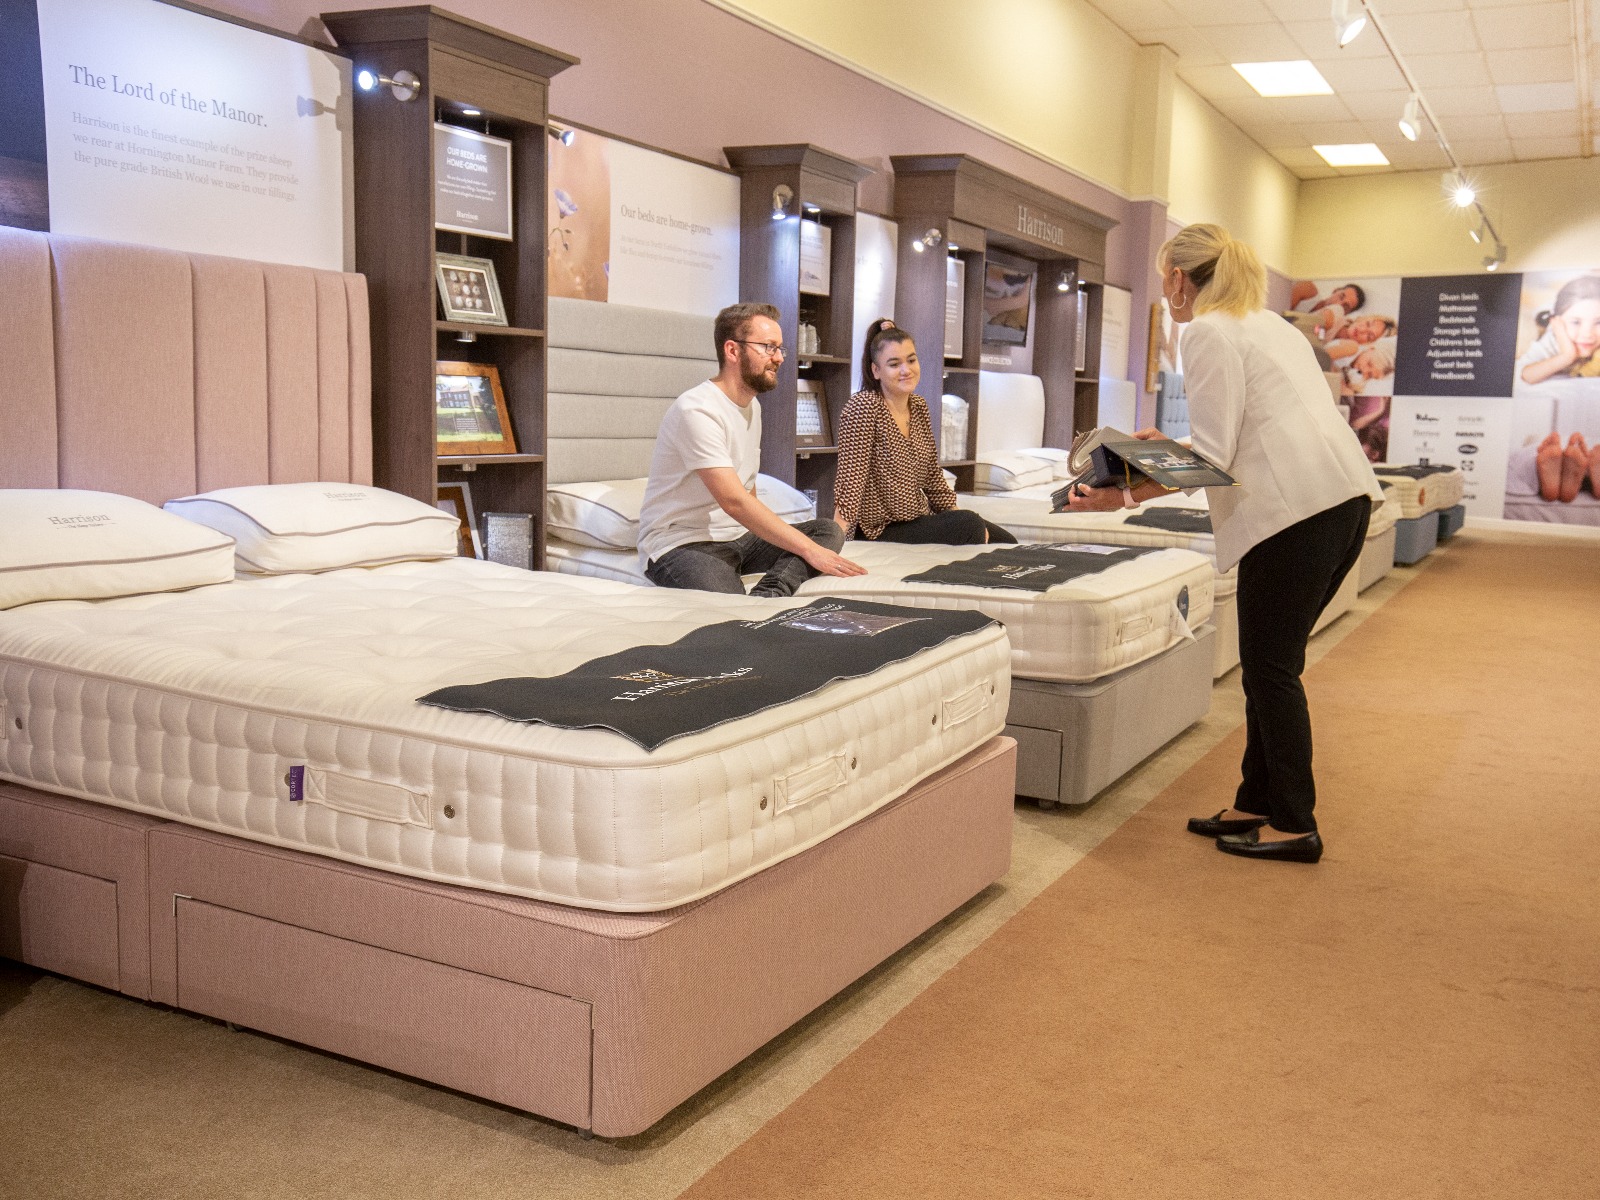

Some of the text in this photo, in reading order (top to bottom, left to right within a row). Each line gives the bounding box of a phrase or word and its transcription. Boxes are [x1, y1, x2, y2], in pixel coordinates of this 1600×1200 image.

[69, 64, 267, 127] The Lord of the Manor.
[72, 112, 120, 131] Harrison
[122, 122, 131, 133] is
[133, 125, 150, 137] the
[151, 129, 178, 144] finest
[180, 136, 218, 152] example
[220, 144, 231, 154] of
[231, 145, 246, 158] the
[447, 146, 460, 156] OUR
[460, 149, 475, 160] BEDS
[72, 133, 88, 144] we
[91, 137, 113, 149] rear
[115, 141, 125, 151] at
[127, 141, 184, 163] Hornington
[186, 153, 218, 169] Manor
[245, 165, 267, 182] They
[73, 151, 91, 163] the
[94, 156, 118, 168] pure
[120, 161, 148, 174] grade
[151, 164, 183, 181] British
[184, 171, 209, 185] Wool
[211, 179, 224, 188] we
[225, 182, 240, 191] use
[241, 182, 251, 193] in
[252, 187, 267, 196] our
[620, 204, 636, 219] Our
[637, 207, 655, 223] beds
[656, 215, 668, 226] are
[1017, 205, 1063, 246] Harrison
[48, 514, 111, 525] Harrison
